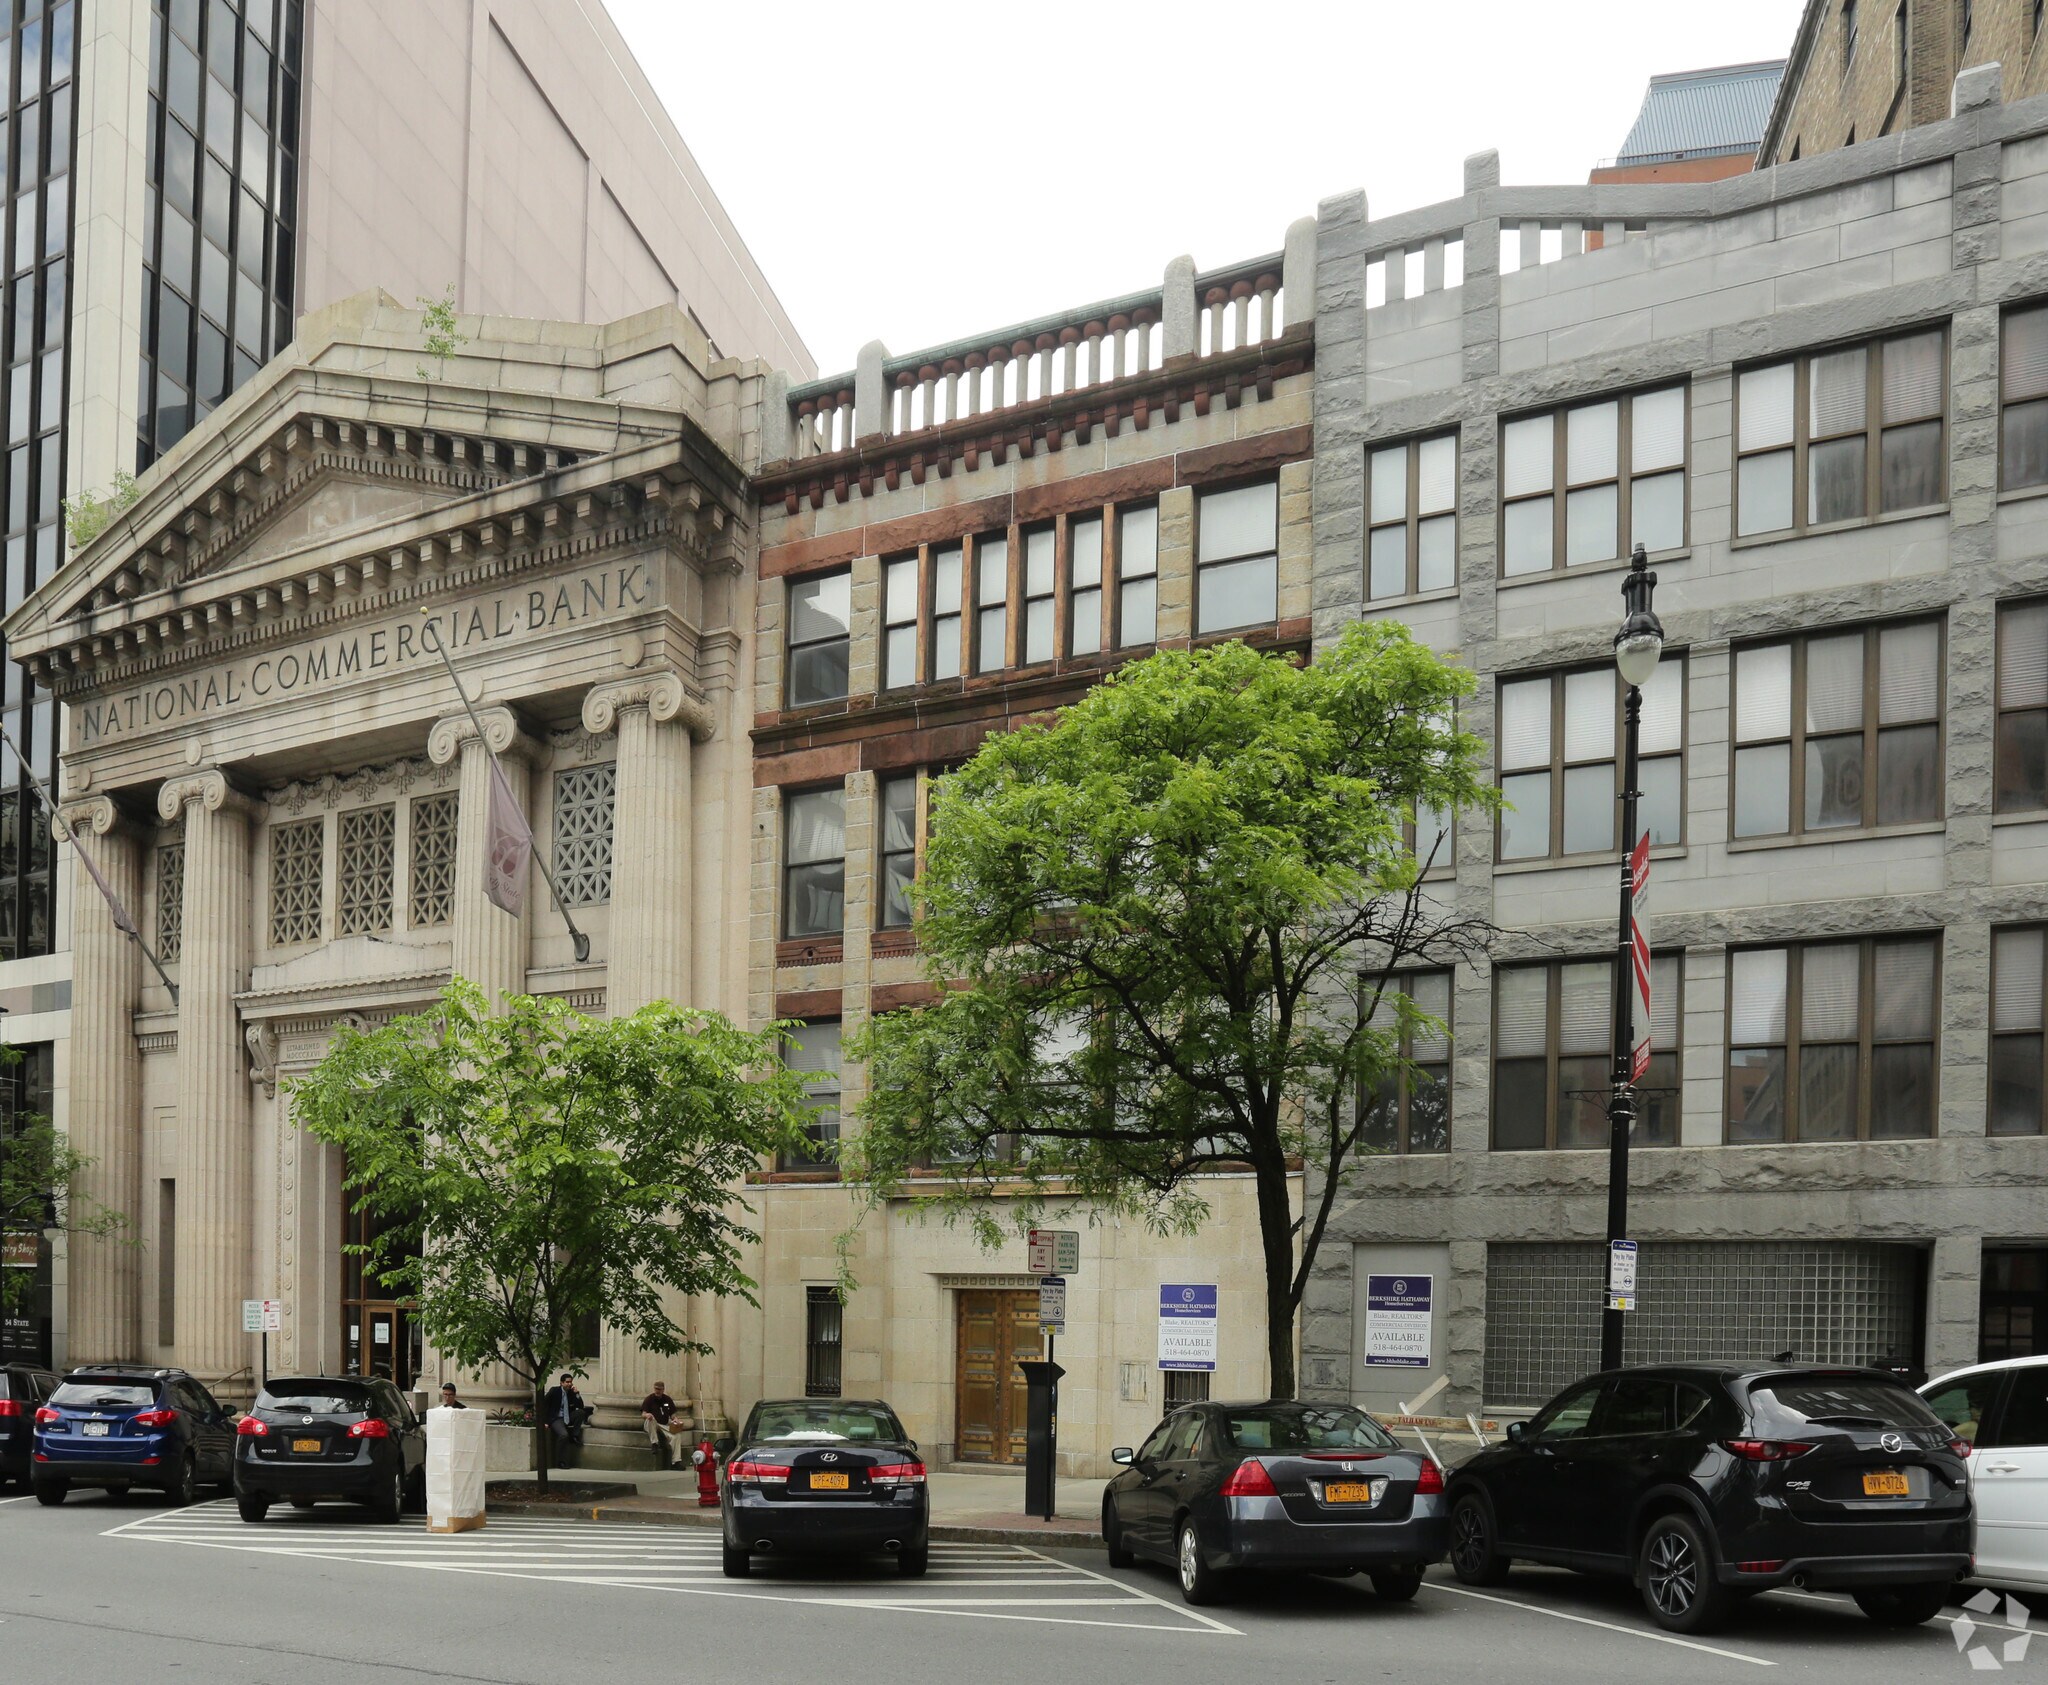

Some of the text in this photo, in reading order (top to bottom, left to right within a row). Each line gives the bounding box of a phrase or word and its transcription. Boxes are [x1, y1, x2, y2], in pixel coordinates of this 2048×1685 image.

[83, 564, 645, 740] NATIONAL COMMERCIAL BANK
[1371, 1332, 1425, 1341] AVAILABLE
[1163, 1338, 1212, 1347] AVAILABLE
[1373, 1343, 1422, 1351] 518-464-0870
[1164, 1348, 1210, 1356] 518-464-0870
